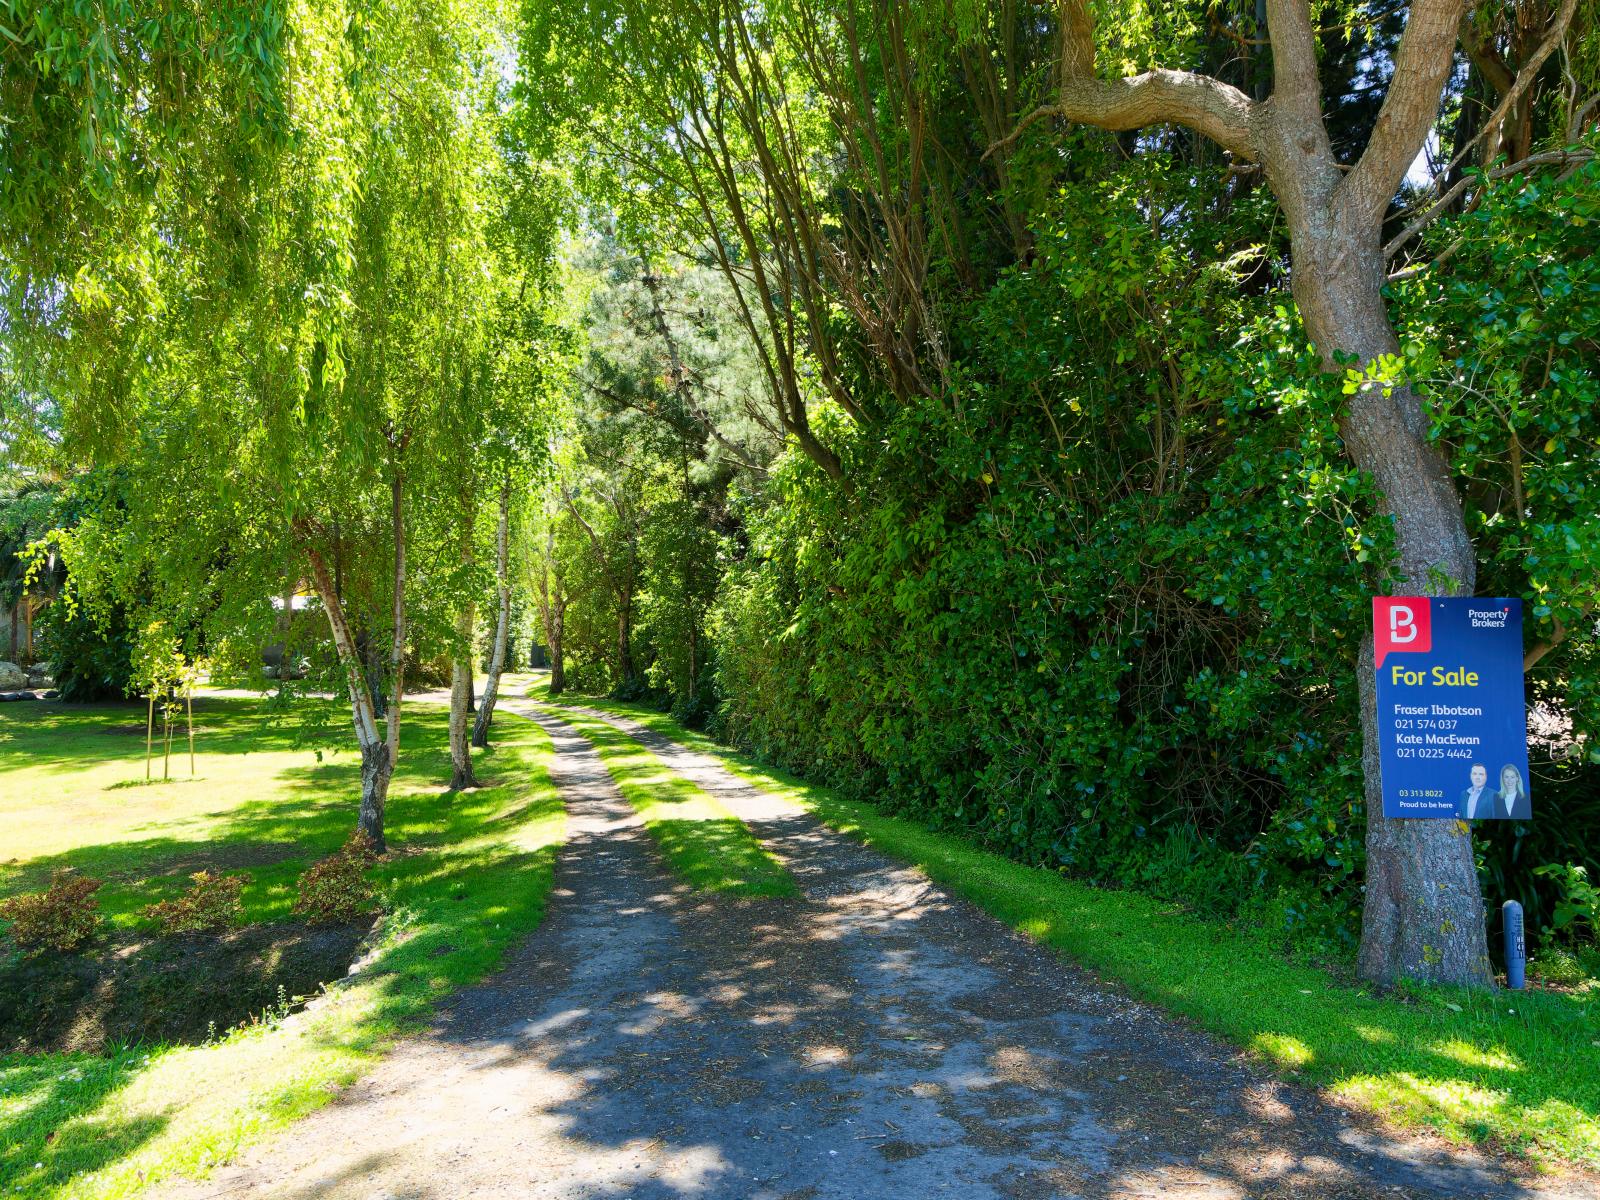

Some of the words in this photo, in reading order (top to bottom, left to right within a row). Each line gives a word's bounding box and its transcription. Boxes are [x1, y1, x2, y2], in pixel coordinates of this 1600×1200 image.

[1468, 609, 1508, 621] Property
[1389, 605, 1418, 643] B
[1471, 618, 1505, 628] Brokers
[1391, 666, 1427, 686] For
[1431, 666, 1479, 687] Sale
[1394, 704, 1428, 715] Fraser
[1431, 704, 1482, 716] Ibbotson
[1395, 719, 1413, 729] 021
[1417, 719, 1436, 729] 574
[1438, 719, 1458, 730] 037
[1396, 733, 1423, 744] Kate
[1425, 734, 1480, 745] MacEwan
[1397, 748, 1415, 758] 021
[1418, 748, 1445, 758] 0225
[1446, 749, 1473, 759] 4442
[1399, 789, 1409, 797] 03
[1410, 789, 1424, 797] 313
[1424, 789, 1443, 798] 8022
[1428, 801, 1438, 809] be
